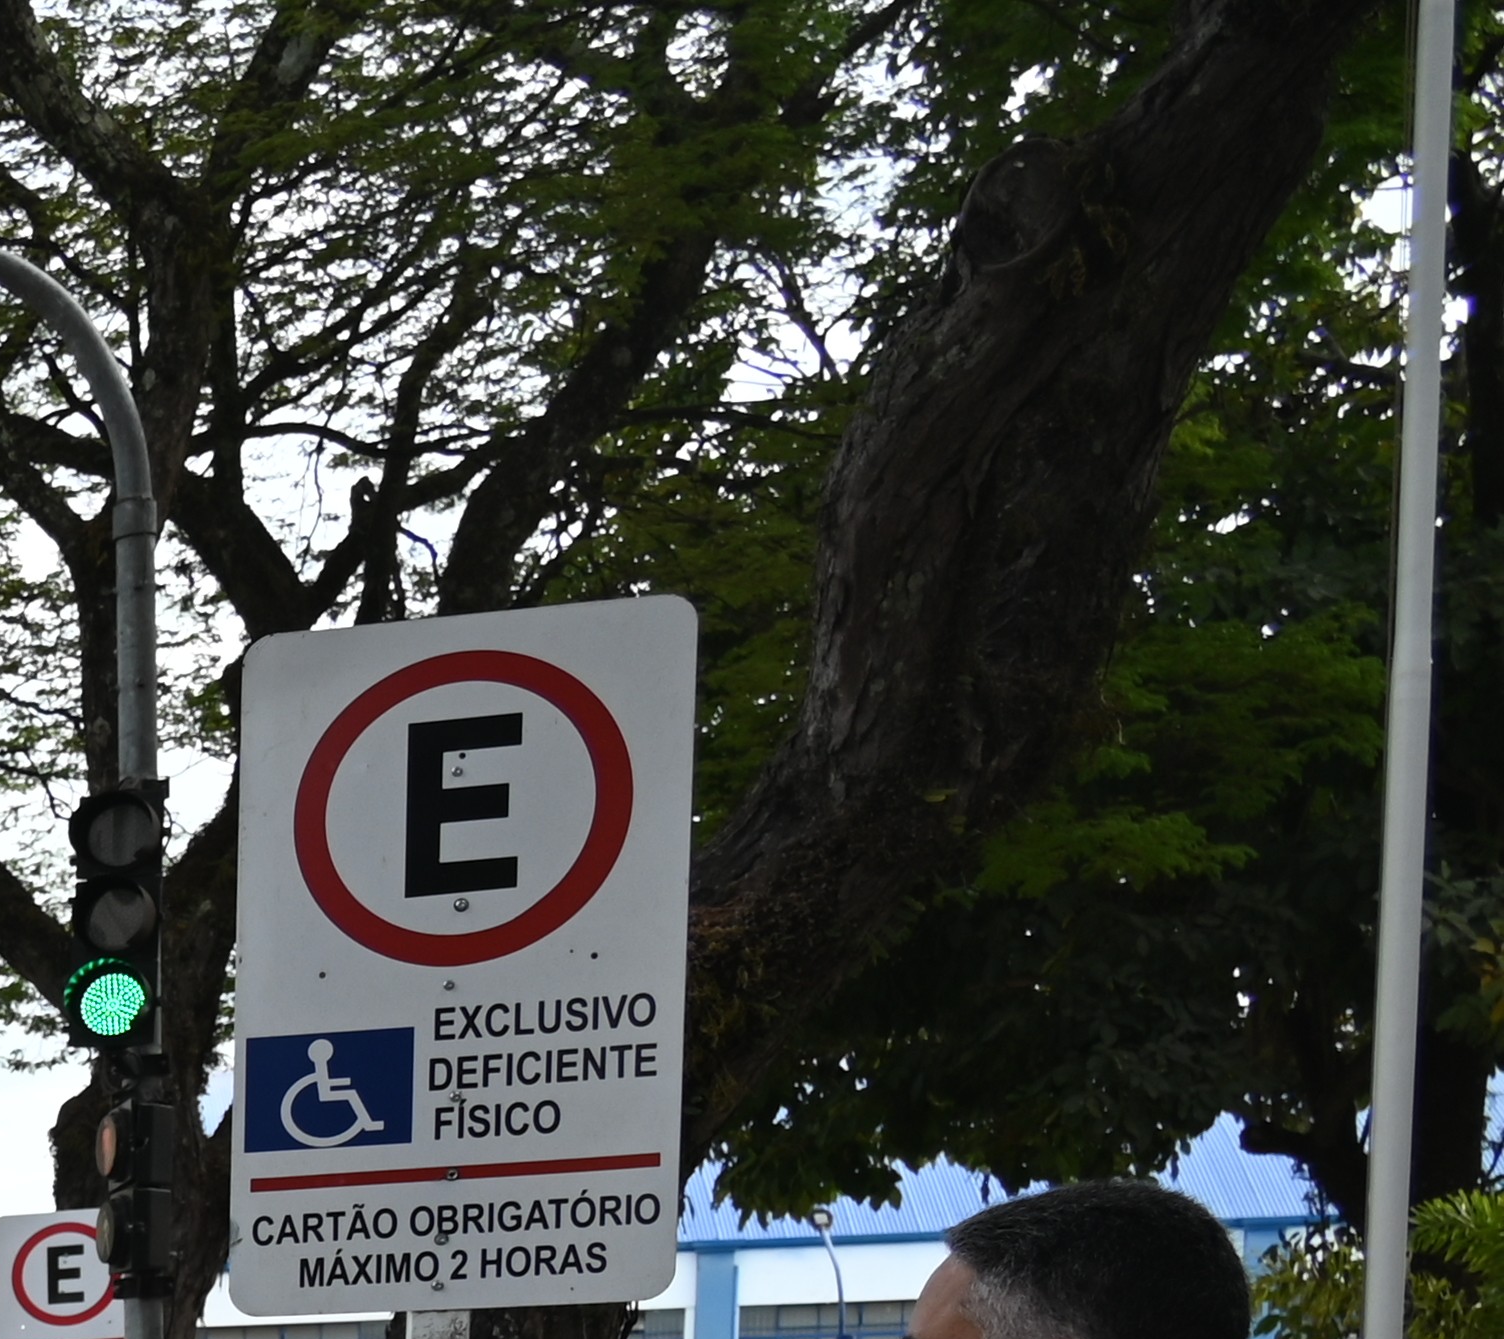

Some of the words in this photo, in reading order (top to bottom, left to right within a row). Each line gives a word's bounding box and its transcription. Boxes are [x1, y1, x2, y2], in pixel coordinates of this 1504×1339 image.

[404, 712, 523, 899] E
[433, 992, 657, 1042] EXCLUSIVO
[429, 1042, 658, 1092] DEFICIENTE
[433, 1097, 561, 1141] FÍSICO
[252, 1203, 398, 1247] CARTÃO
[410, 1189, 661, 1237] OBRIGATÓRIO
[47, 1244, 85, 1305] E
[299, 1247, 440, 1289] MÁXIMO
[450, 1252, 468, 1281] 2
[479, 1242, 608, 1280] HORAS
